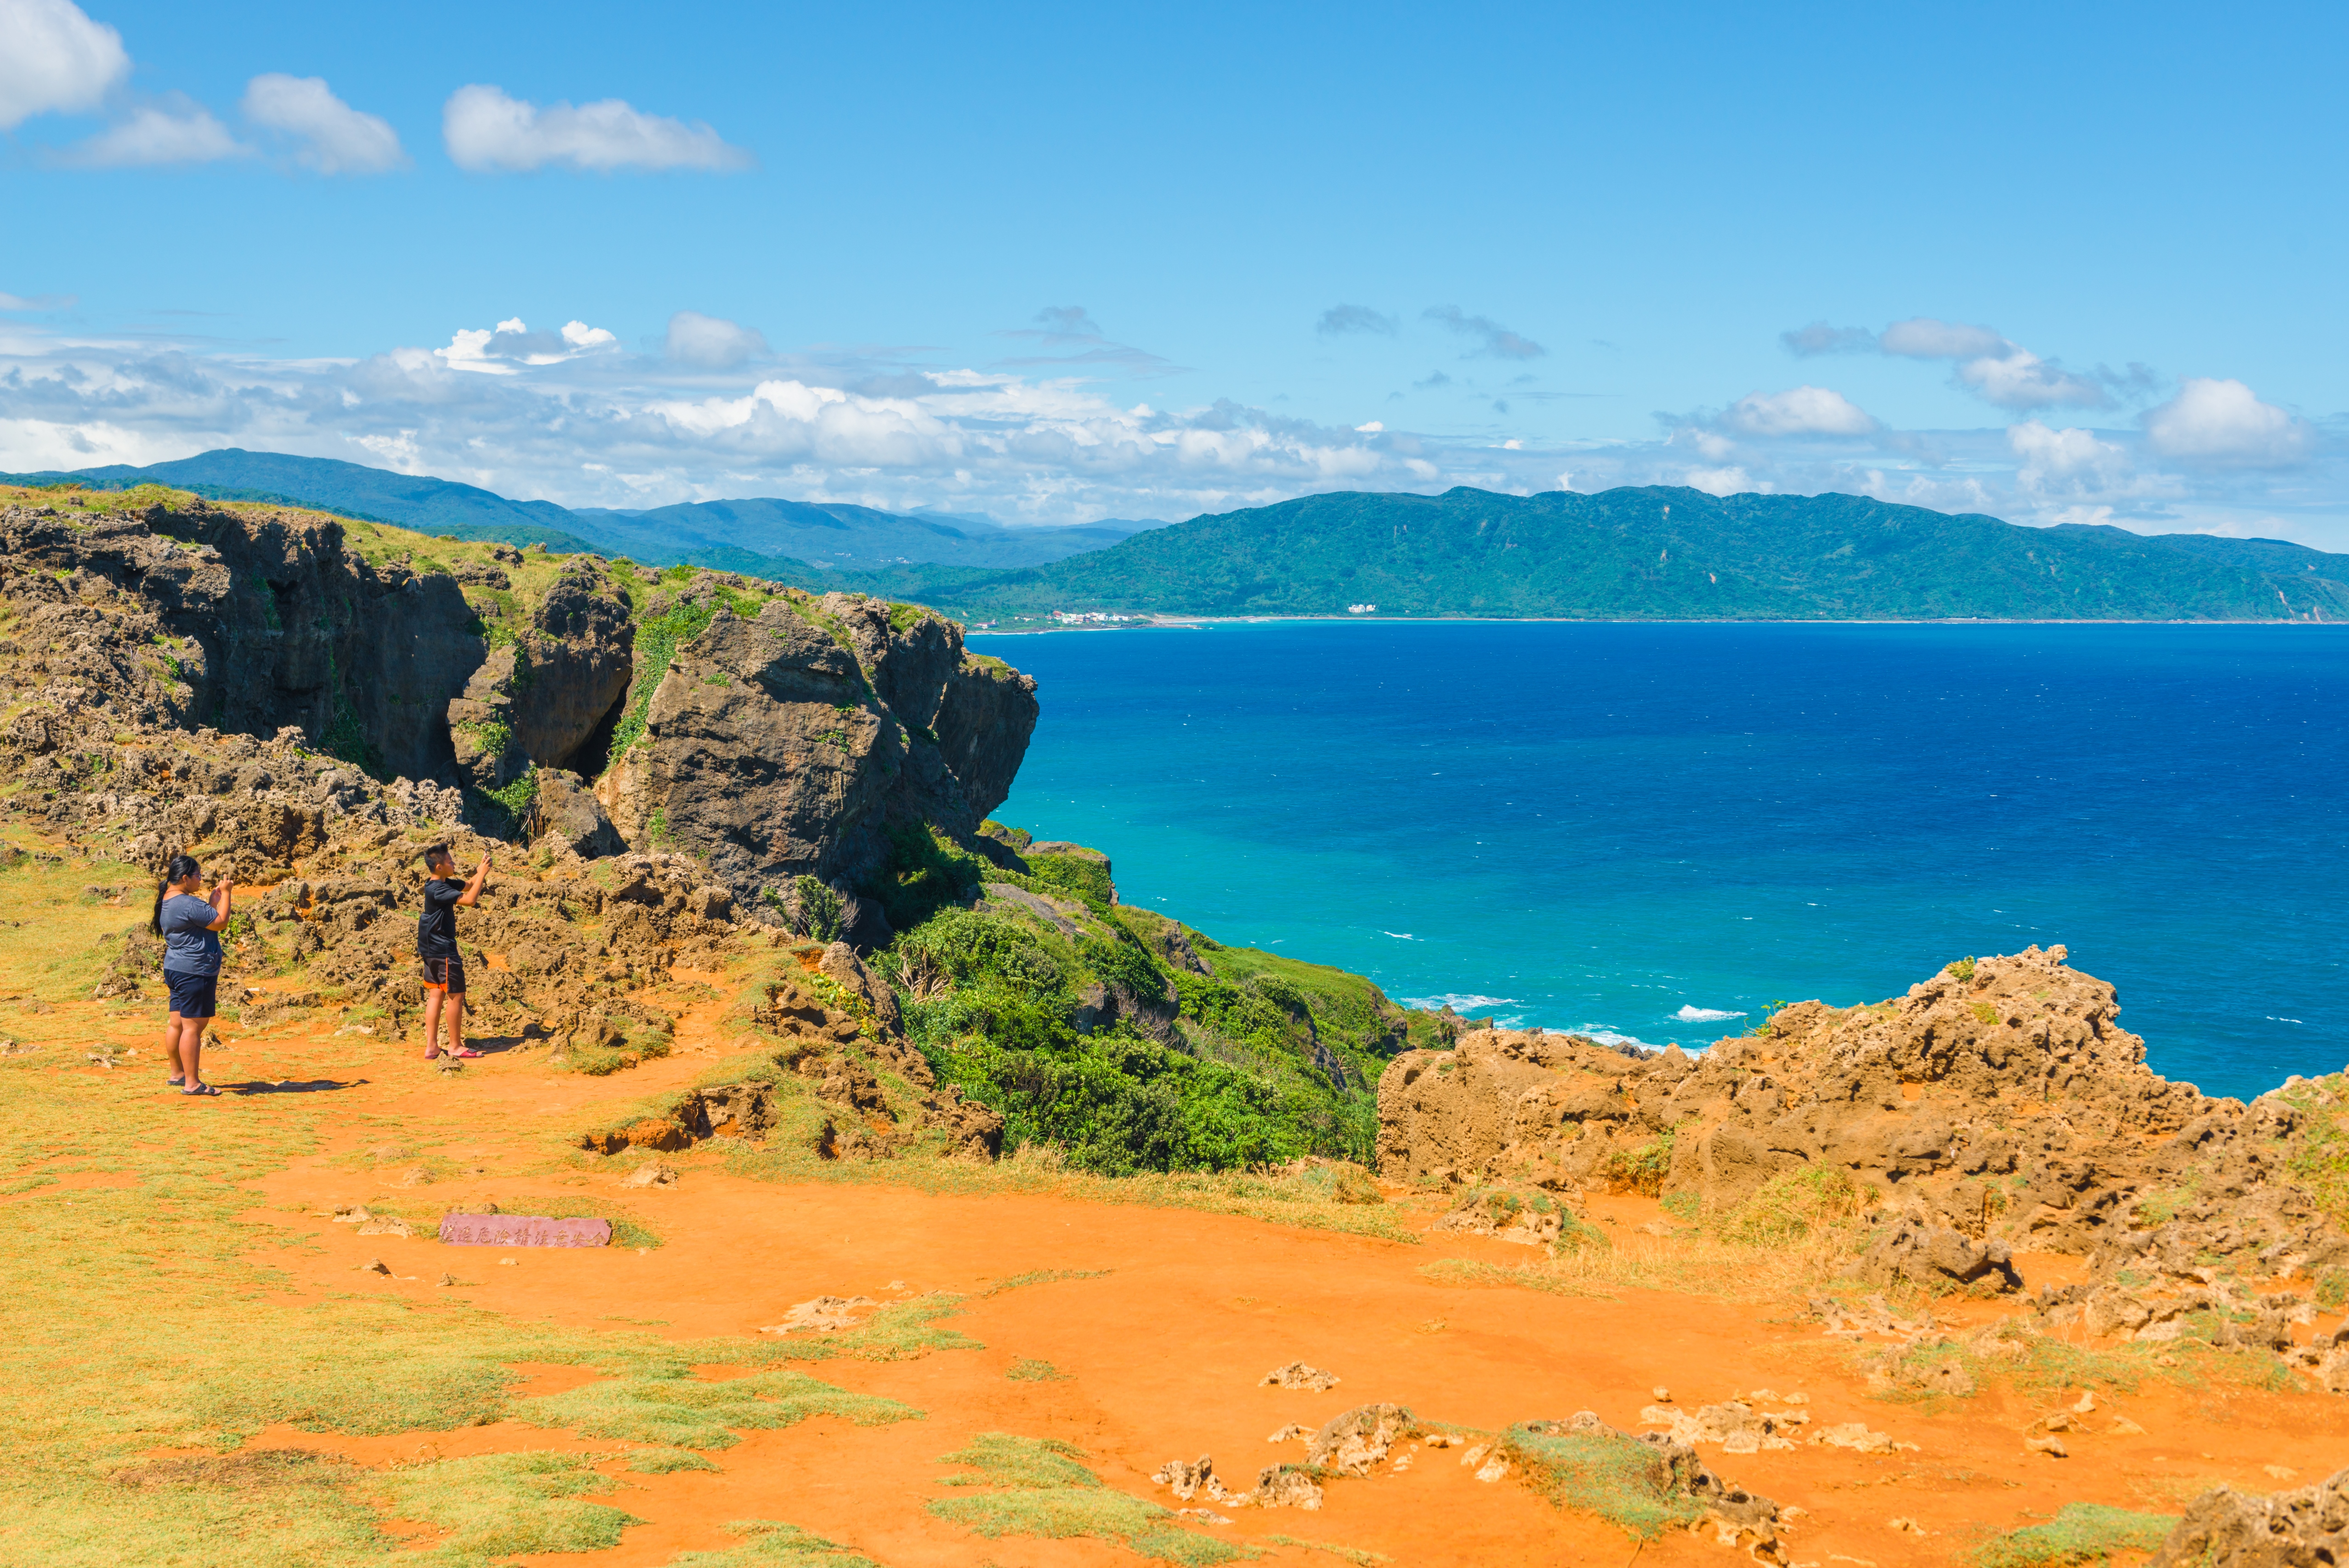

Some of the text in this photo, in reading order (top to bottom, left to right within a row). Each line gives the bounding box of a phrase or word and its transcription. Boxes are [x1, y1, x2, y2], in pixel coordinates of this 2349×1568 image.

[442, 1225, 606, 1247] 崖邊危險請注意安全
